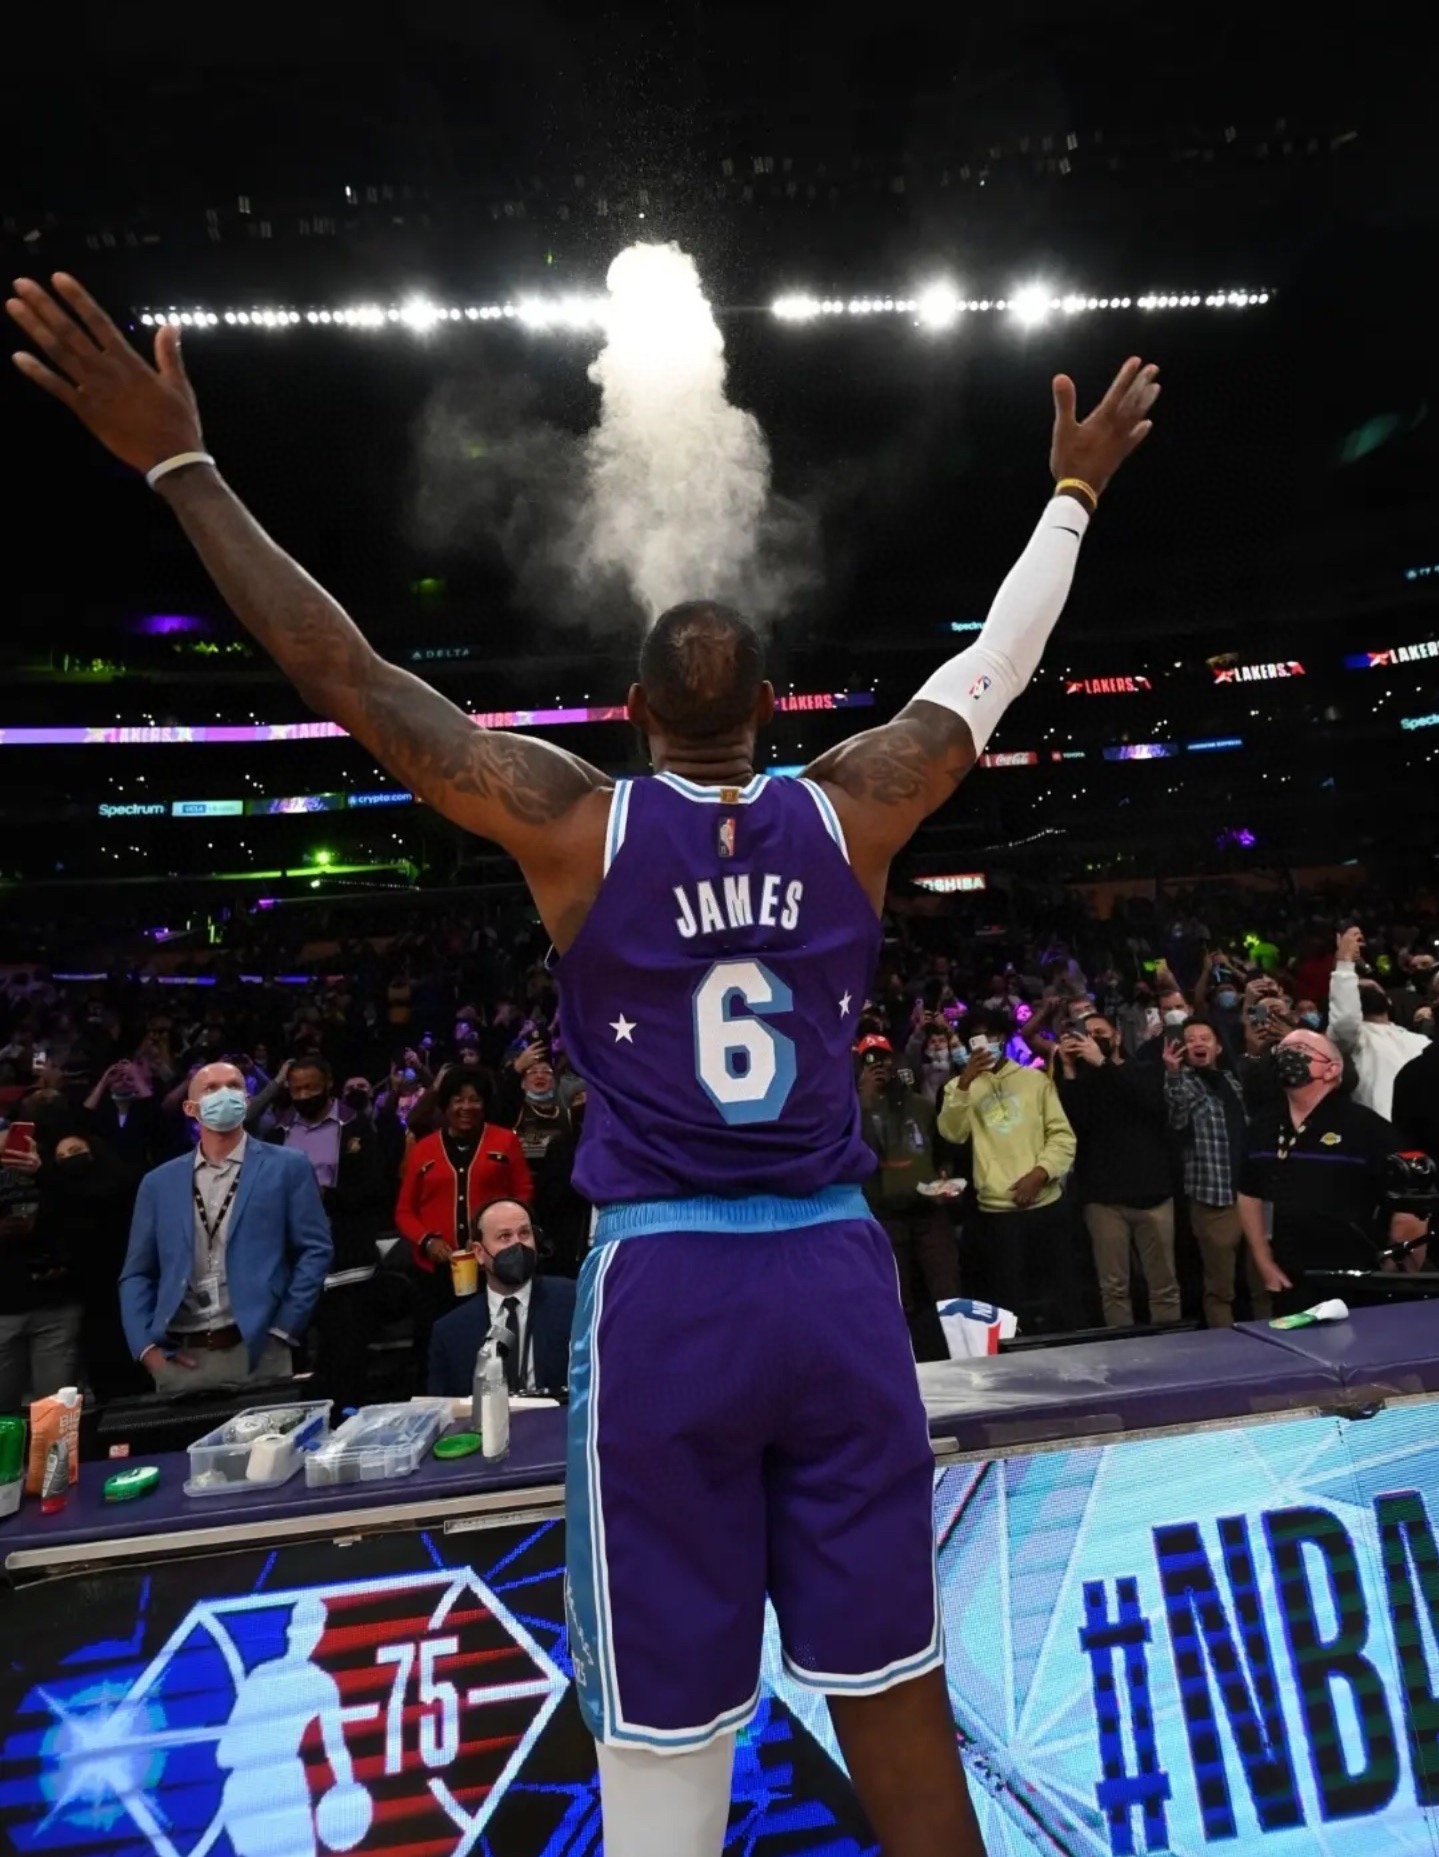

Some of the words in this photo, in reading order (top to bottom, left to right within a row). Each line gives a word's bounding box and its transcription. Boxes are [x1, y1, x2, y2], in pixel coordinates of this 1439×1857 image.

[426, 648, 470, 659] DELTA
[1389, 641, 1439, 664] LAKER
[1234, 663, 1286, 682] LAKERS
[1084, 677, 1133, 694] LAKERS
[780, 694, 832, 711] LAKERS
[358, 794, 412, 804] crypto.com
[99, 803, 164, 818] Spectrum
[673, 873, 803, 939] JAMES
[691, 959, 795, 1123] 6
[376, 1635, 459, 1776] 75
